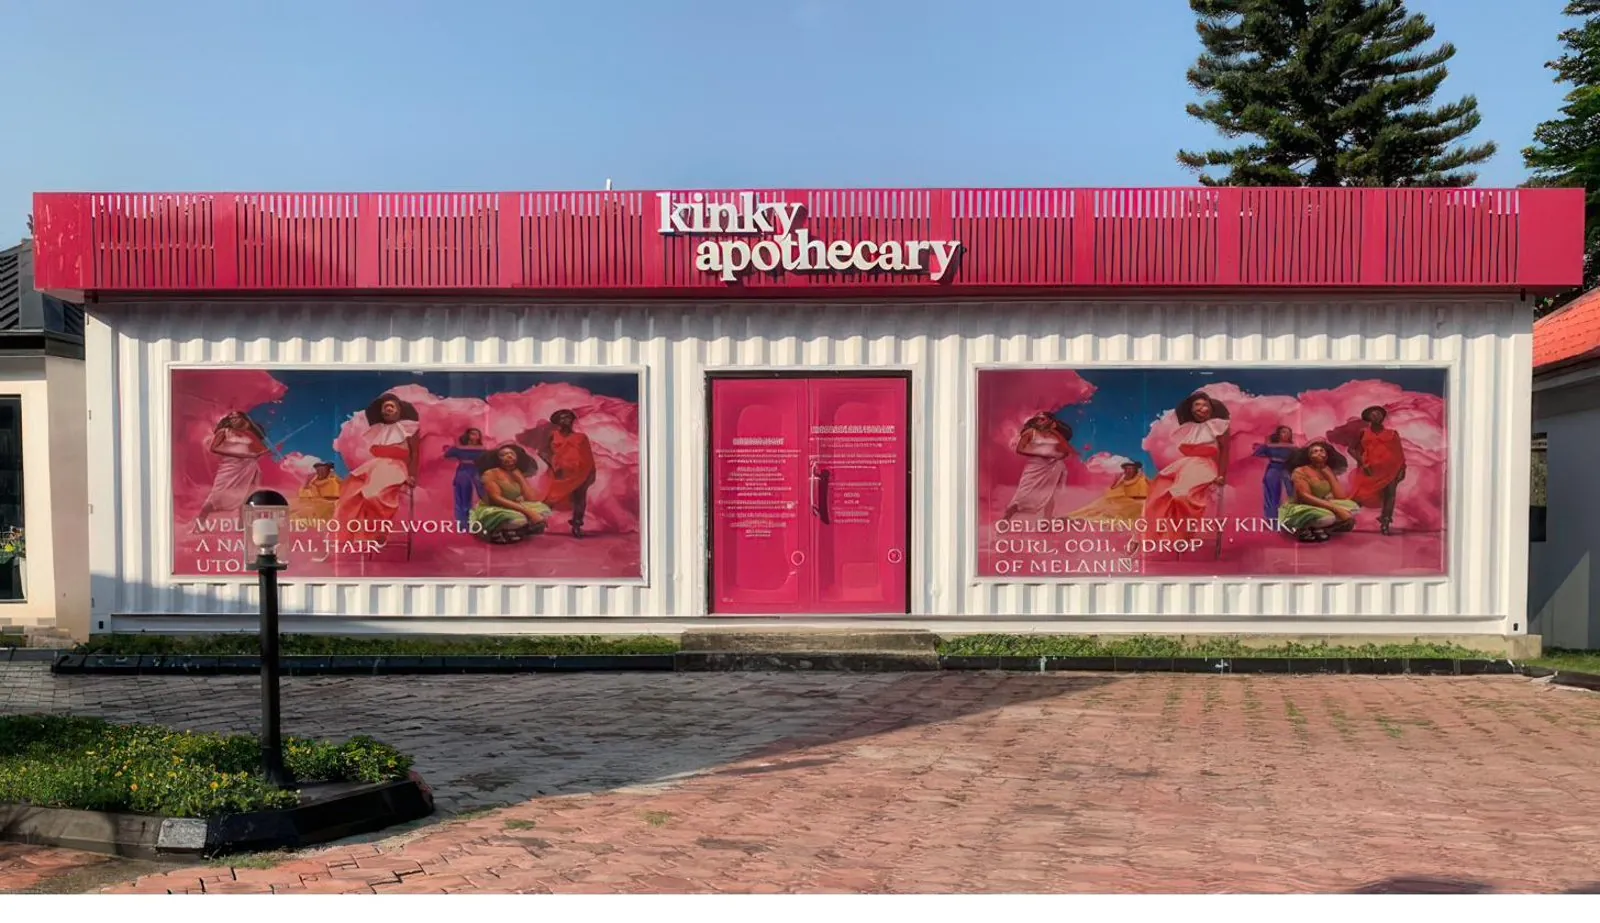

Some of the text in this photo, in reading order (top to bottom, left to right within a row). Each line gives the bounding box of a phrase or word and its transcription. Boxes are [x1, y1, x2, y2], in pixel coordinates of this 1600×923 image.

[656, 191, 804, 239] kinky
[695, 229, 960, 282] apothecary
[195, 518, 307, 532] WELE
[346, 519, 394, 533] OUR
[400, 519, 488, 533] WORLD.
[995, 517, 1297, 534] CELEBRATING EVERY KINK,
[195, 539, 381, 553] A NAAL HAIR
[995, 539, 1059, 554] CURL,
[1142, 538, 1204, 553] DROP
[995, 559, 1023, 573] OF
